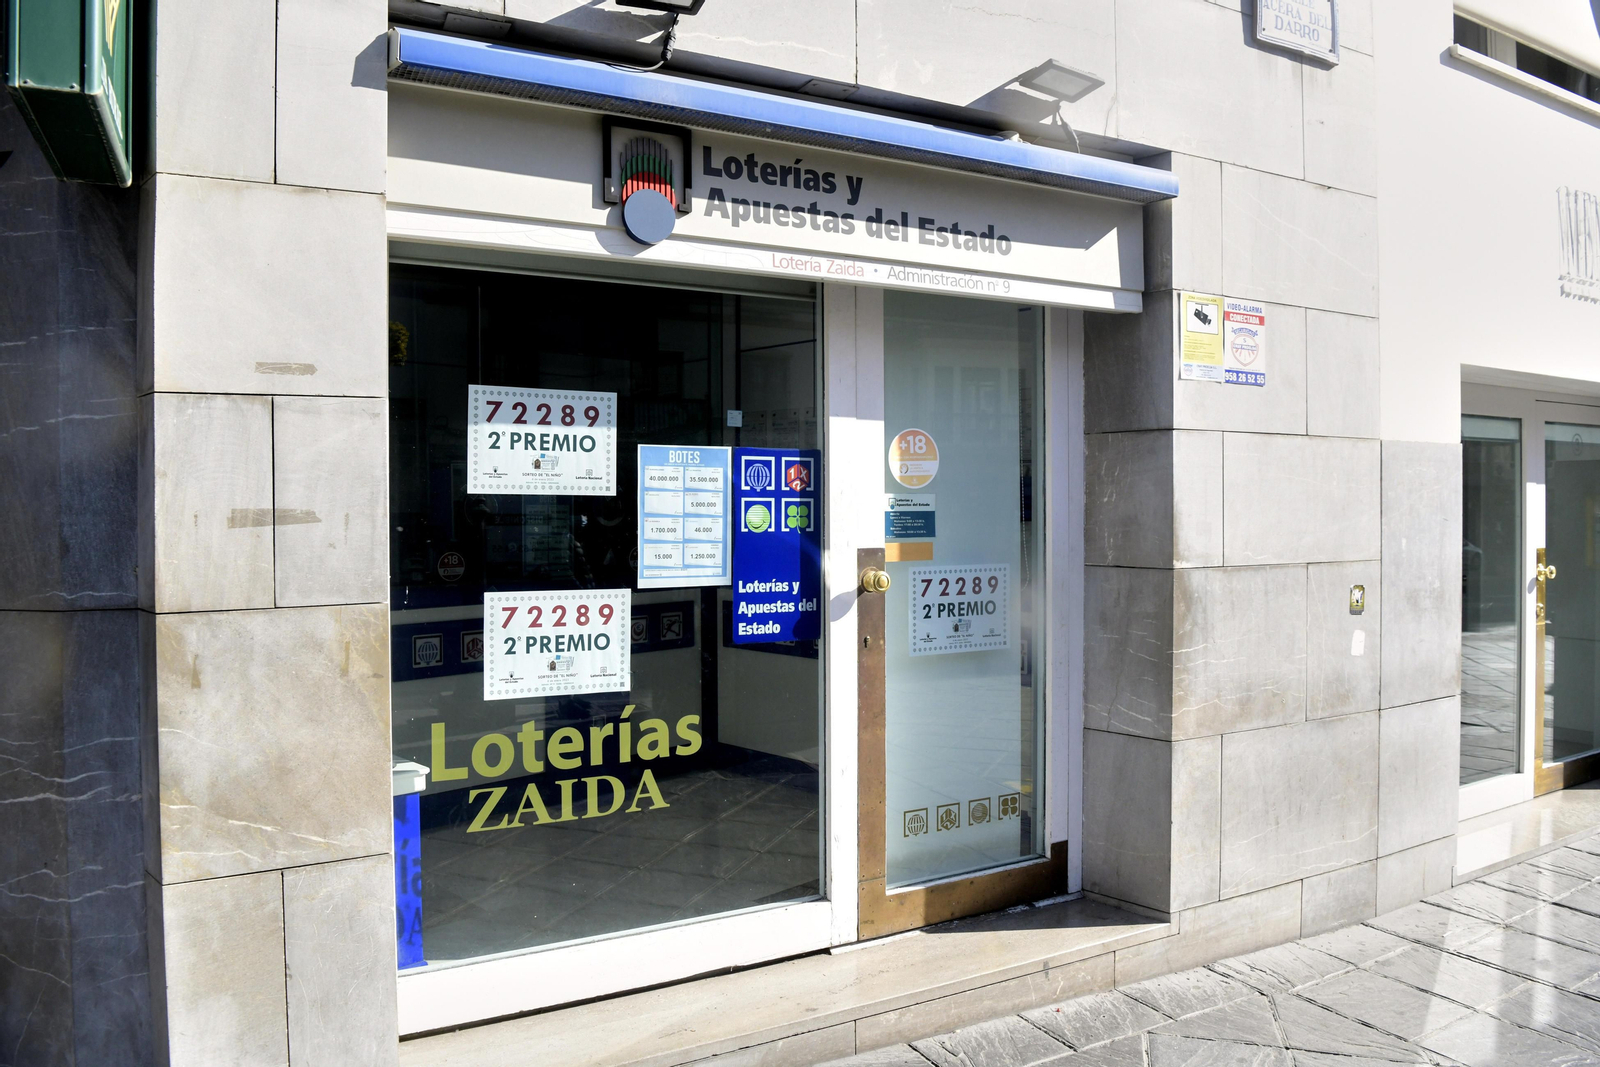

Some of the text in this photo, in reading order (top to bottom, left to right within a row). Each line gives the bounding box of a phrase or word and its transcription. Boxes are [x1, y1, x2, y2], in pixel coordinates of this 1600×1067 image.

[1274, 14, 1320, 42] DARRO
[703, 145, 863, 206] Loterías y
[704, 187, 1012, 256] Apuestas del Estado
[772, 253, 864, 277] Lotería Zaida
[887, 266, 984, 290] Administración
[1003, 280, 1010, 293] 9
[1227, 303, 1262, 314] VIDEO-ALARMA
[1229, 313, 1260, 324] CONECTADA
[1225, 371, 1237, 381] 958
[1238, 373, 1246, 382] 26
[1247, 374, 1255, 383] 52
[1257, 375, 1265, 384] 55
[485, 400, 600, 427] 72289
[510, 432, 596, 453] PREMIO
[899, 435, 927, 454] +18
[669, 450, 700, 464] BOTES
[738, 579, 800, 595] Loterías y
[921, 576, 998, 597] 72289
[501, 603, 614, 629] 72289
[738, 598, 817, 617] Apuestas del
[938, 600, 996, 618] PREMIO
[738, 621, 781, 635] Estado
[526, 633, 610, 654] PREMIO
[431, 705, 702, 782] Loterías
[466, 768, 670, 833] ZAIDA
